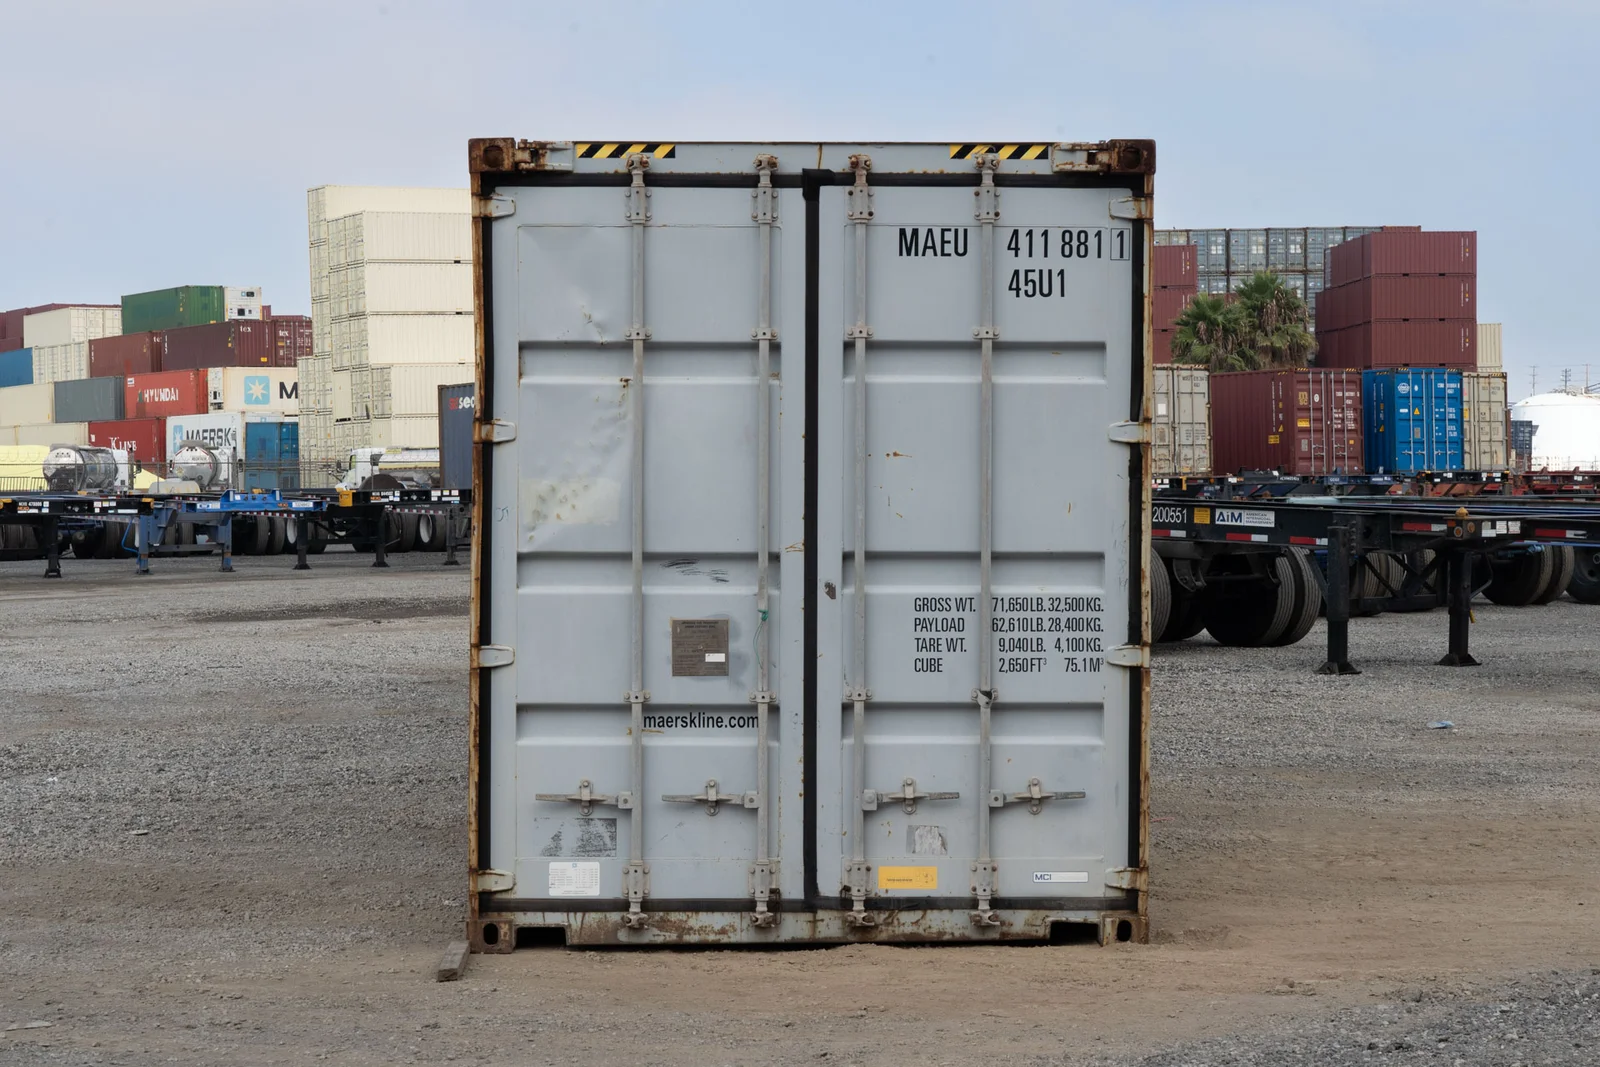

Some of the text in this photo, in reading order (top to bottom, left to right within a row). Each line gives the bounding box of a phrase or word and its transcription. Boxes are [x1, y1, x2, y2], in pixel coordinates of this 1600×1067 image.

[898, 228, 1128, 260] MAEU 411 881 1
[1008, 269, 1066, 298] 45U1
[144, 387, 179, 402] HYUNDAI
[186, 428, 232, 447] MAERSK
[1152, 506, 1187, 523] 200551
[914, 597, 952, 612] GROSS
[954, 597, 976, 612] WT.
[914, 618, 965, 632] PAYLOAD
[914, 638, 942, 652] TARE
[946, 638, 967, 652] WT.
[914, 658, 943, 673] CUBE
[643, 712, 758, 728] maerskline.com
